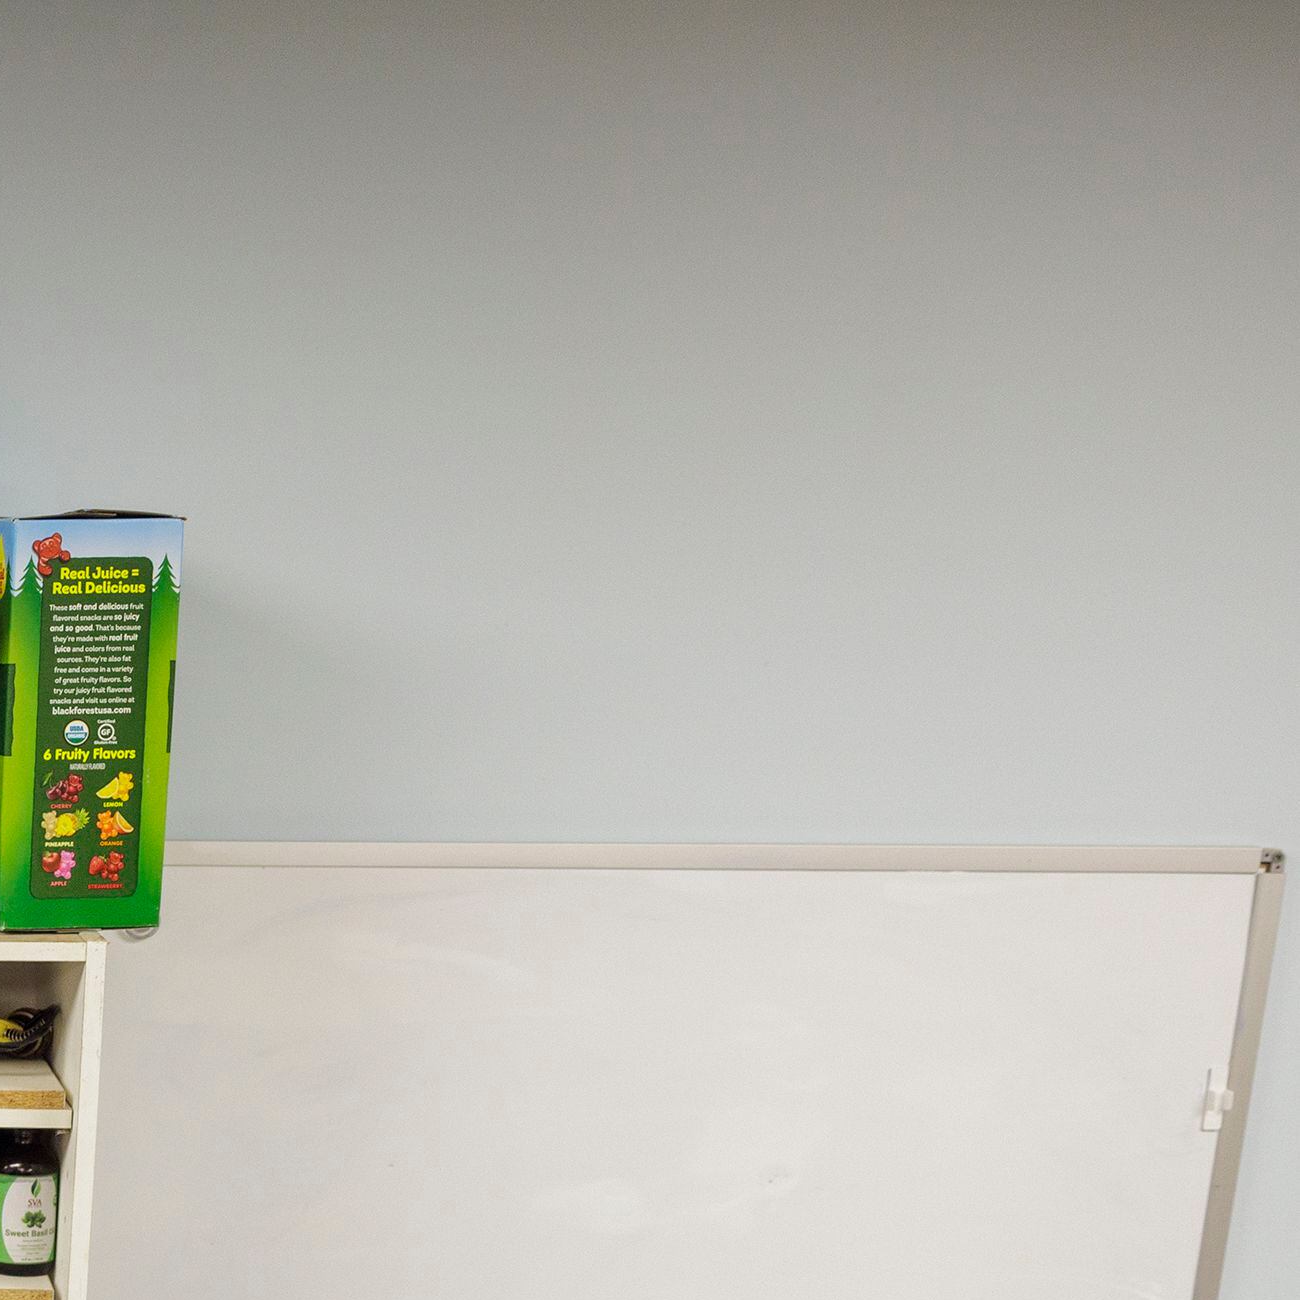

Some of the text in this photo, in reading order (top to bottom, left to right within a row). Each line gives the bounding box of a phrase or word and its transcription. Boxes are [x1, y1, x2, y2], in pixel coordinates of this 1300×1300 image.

[60, 566, 128, 580] Real Juice
[52, 581, 146, 594] Real Delicious
[50, 603, 144, 611] These soft and delicious fruit
[53, 613, 79, 622] flavored
[114, 613, 122, 622] so
[124, 613, 140, 622] juicy
[50, 624, 64, 635] and
[75, 624, 95, 635] good.
[109, 634, 138, 644] real fruit
[52, 706, 131, 715] blackforestusa.com
[101, 728, 111, 736] GF
[43, 747, 136, 762] 6 Fruity Flavors
[27, 1200, 42, 1208] SVA
[5, 1229, 30, 1238] Sweet
[31, 1230, 48, 1238] Basil
